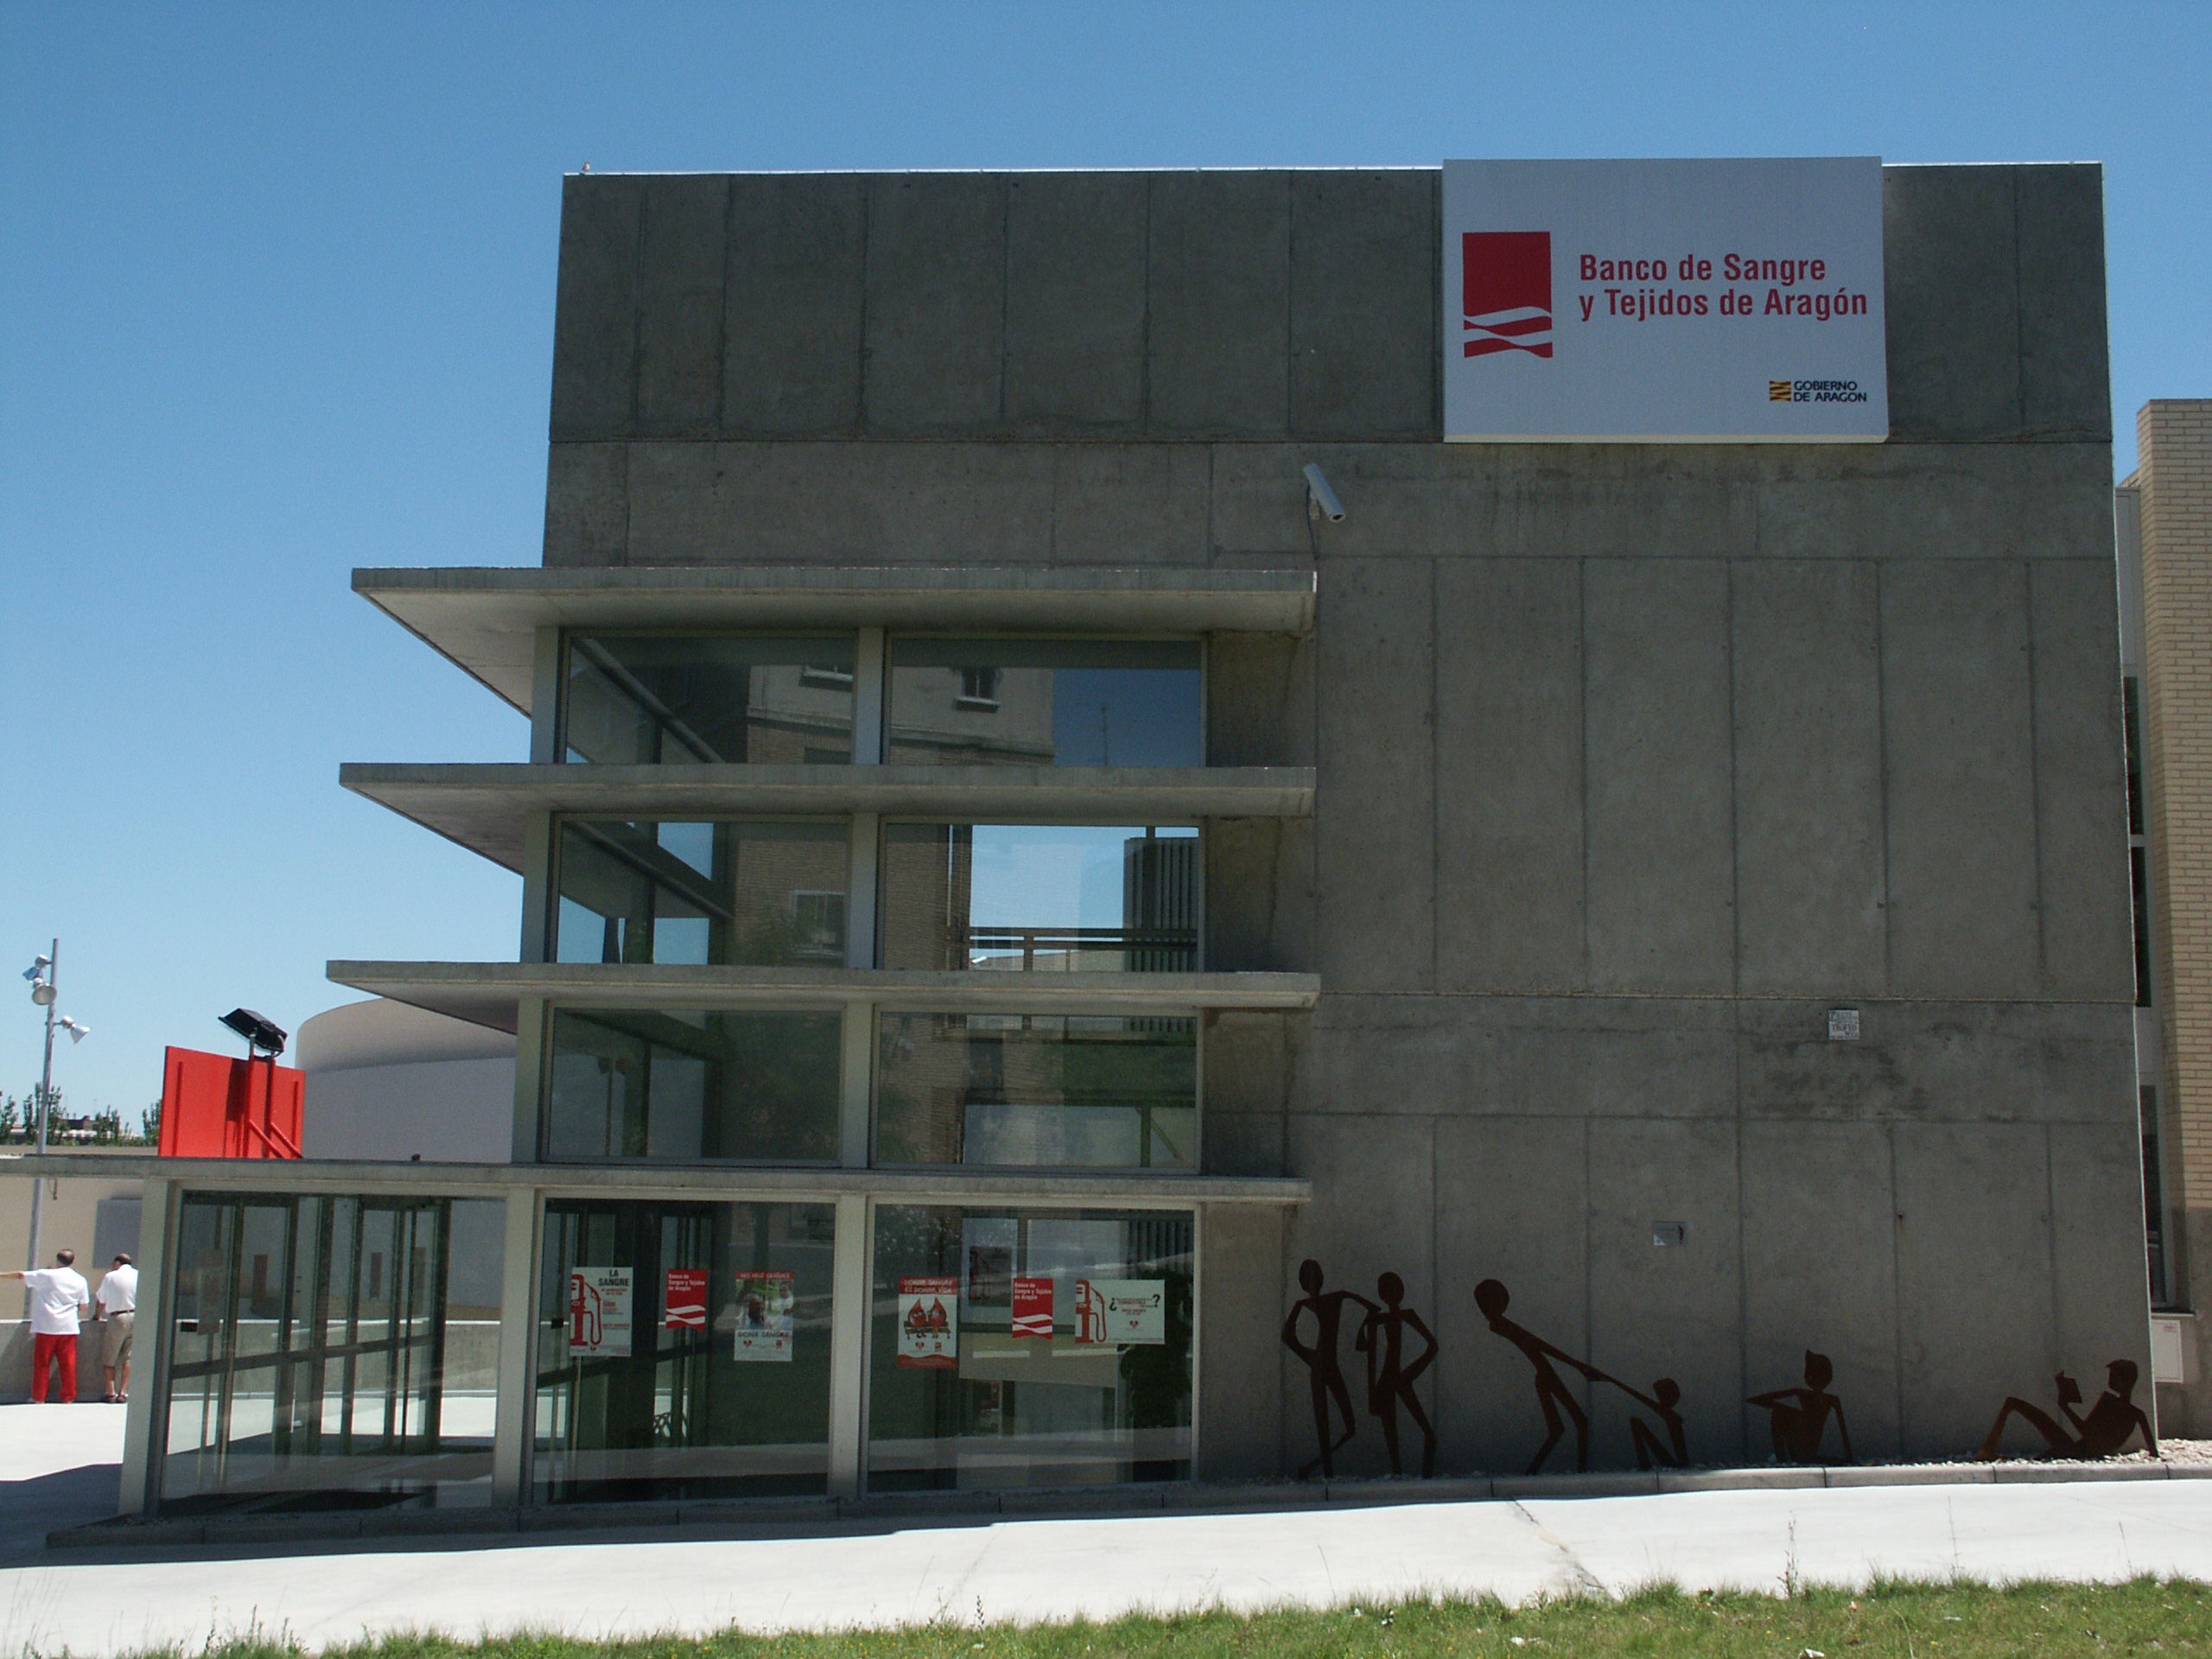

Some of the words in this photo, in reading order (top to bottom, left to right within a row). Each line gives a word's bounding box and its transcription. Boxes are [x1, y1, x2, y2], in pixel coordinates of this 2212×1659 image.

[1580, 254, 1667, 281] Banco
[1679, 254, 1712, 281] de
[1724, 253, 1826, 287] Sangre
[1580, 296, 1594, 322] y
[1605, 289, 1708, 322] Tejidos
[1719, 289, 1753, 316] de
[1764, 287, 1867, 321] Aragón
[1794, 380, 1858, 391] GOBIERNO
[1794, 391, 1811, 403] DE
[1815, 391, 1867, 403] ARAGON
[598, 1278, 629, 1287] SANGRE
